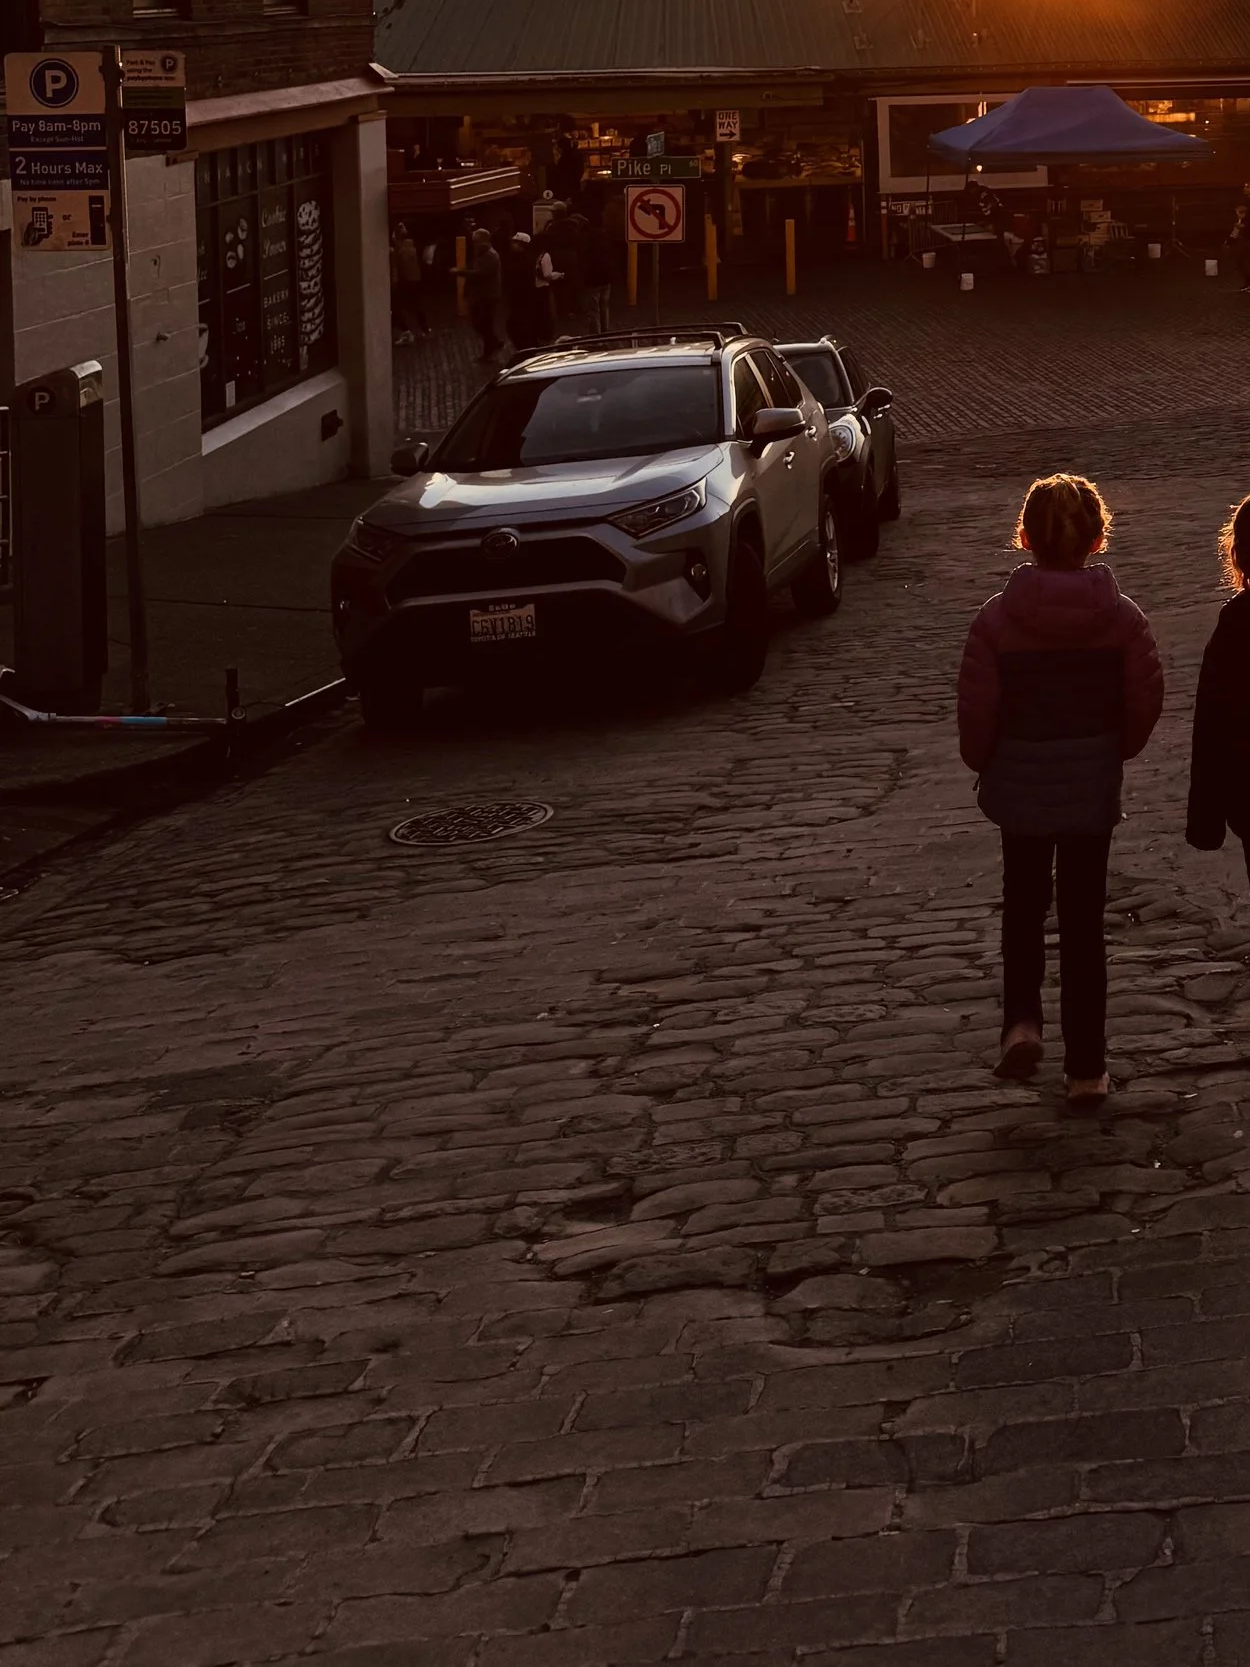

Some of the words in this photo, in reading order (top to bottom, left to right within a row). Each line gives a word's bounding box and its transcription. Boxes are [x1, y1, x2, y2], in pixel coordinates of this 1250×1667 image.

[44, 69, 68, 98] P
[719, 111, 737, 120] ONE
[12, 120, 36, 134] Pay
[38, 120, 101, 134] 8am-8pm
[128, 120, 181, 135] 87505
[719, 120, 738, 130] WAY
[15, 156, 27, 175] 2
[31, 161, 72, 174] Hours
[75, 161, 103, 174] Max
[617, 160, 651, 176] Pike
[660, 163, 672, 175] Pl
[33, 391, 51, 411] P
